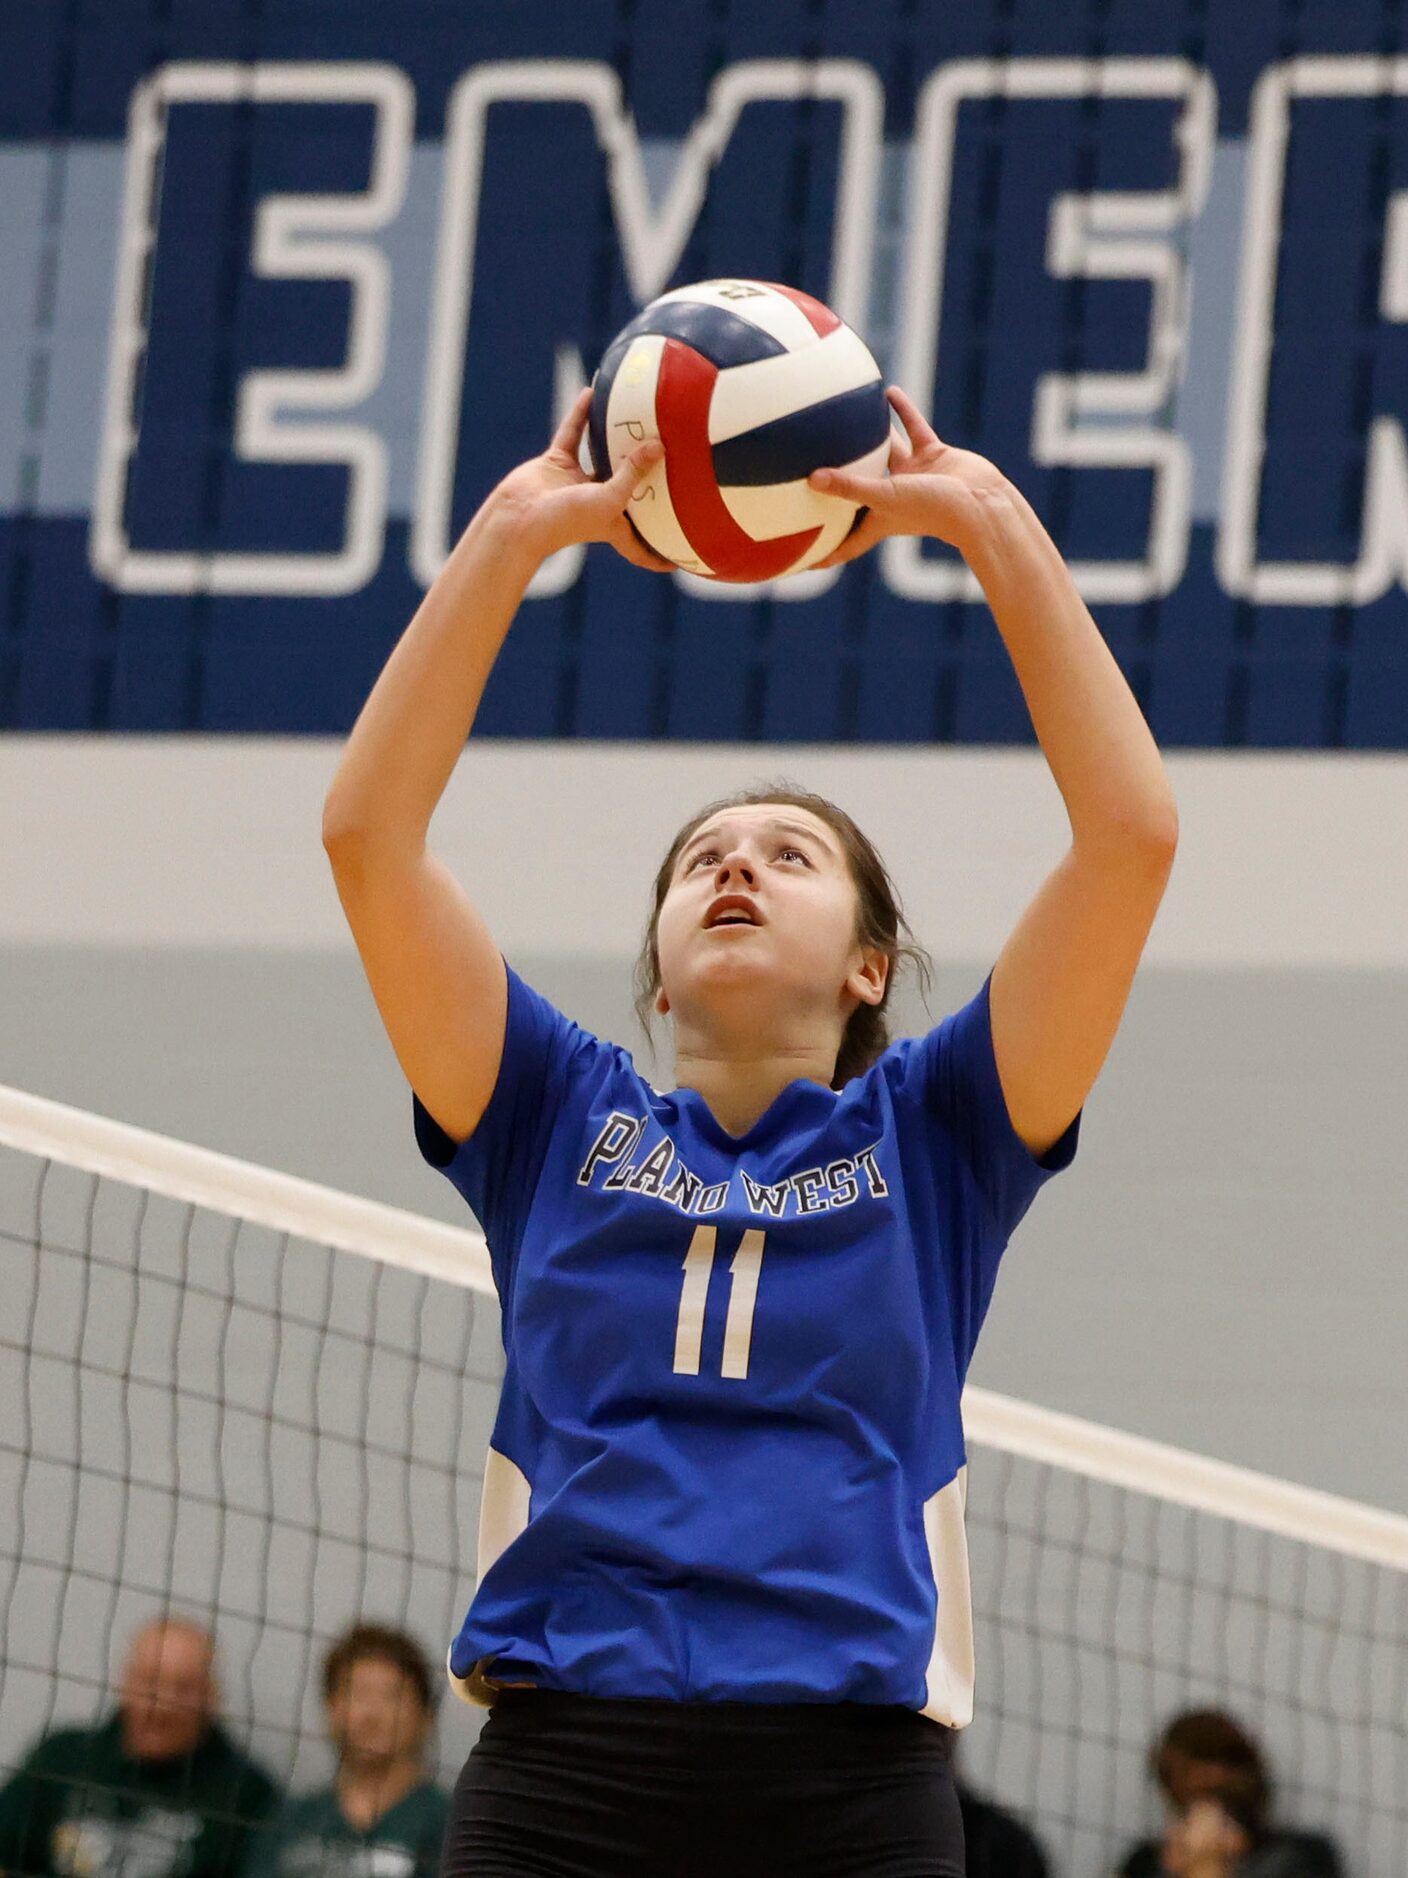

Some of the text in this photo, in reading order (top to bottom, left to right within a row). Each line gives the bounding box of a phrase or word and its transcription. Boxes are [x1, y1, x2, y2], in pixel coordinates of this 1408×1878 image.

[575, 1109, 890, 1219] PLANO WEST
[671, 1223, 768, 1381] 11
